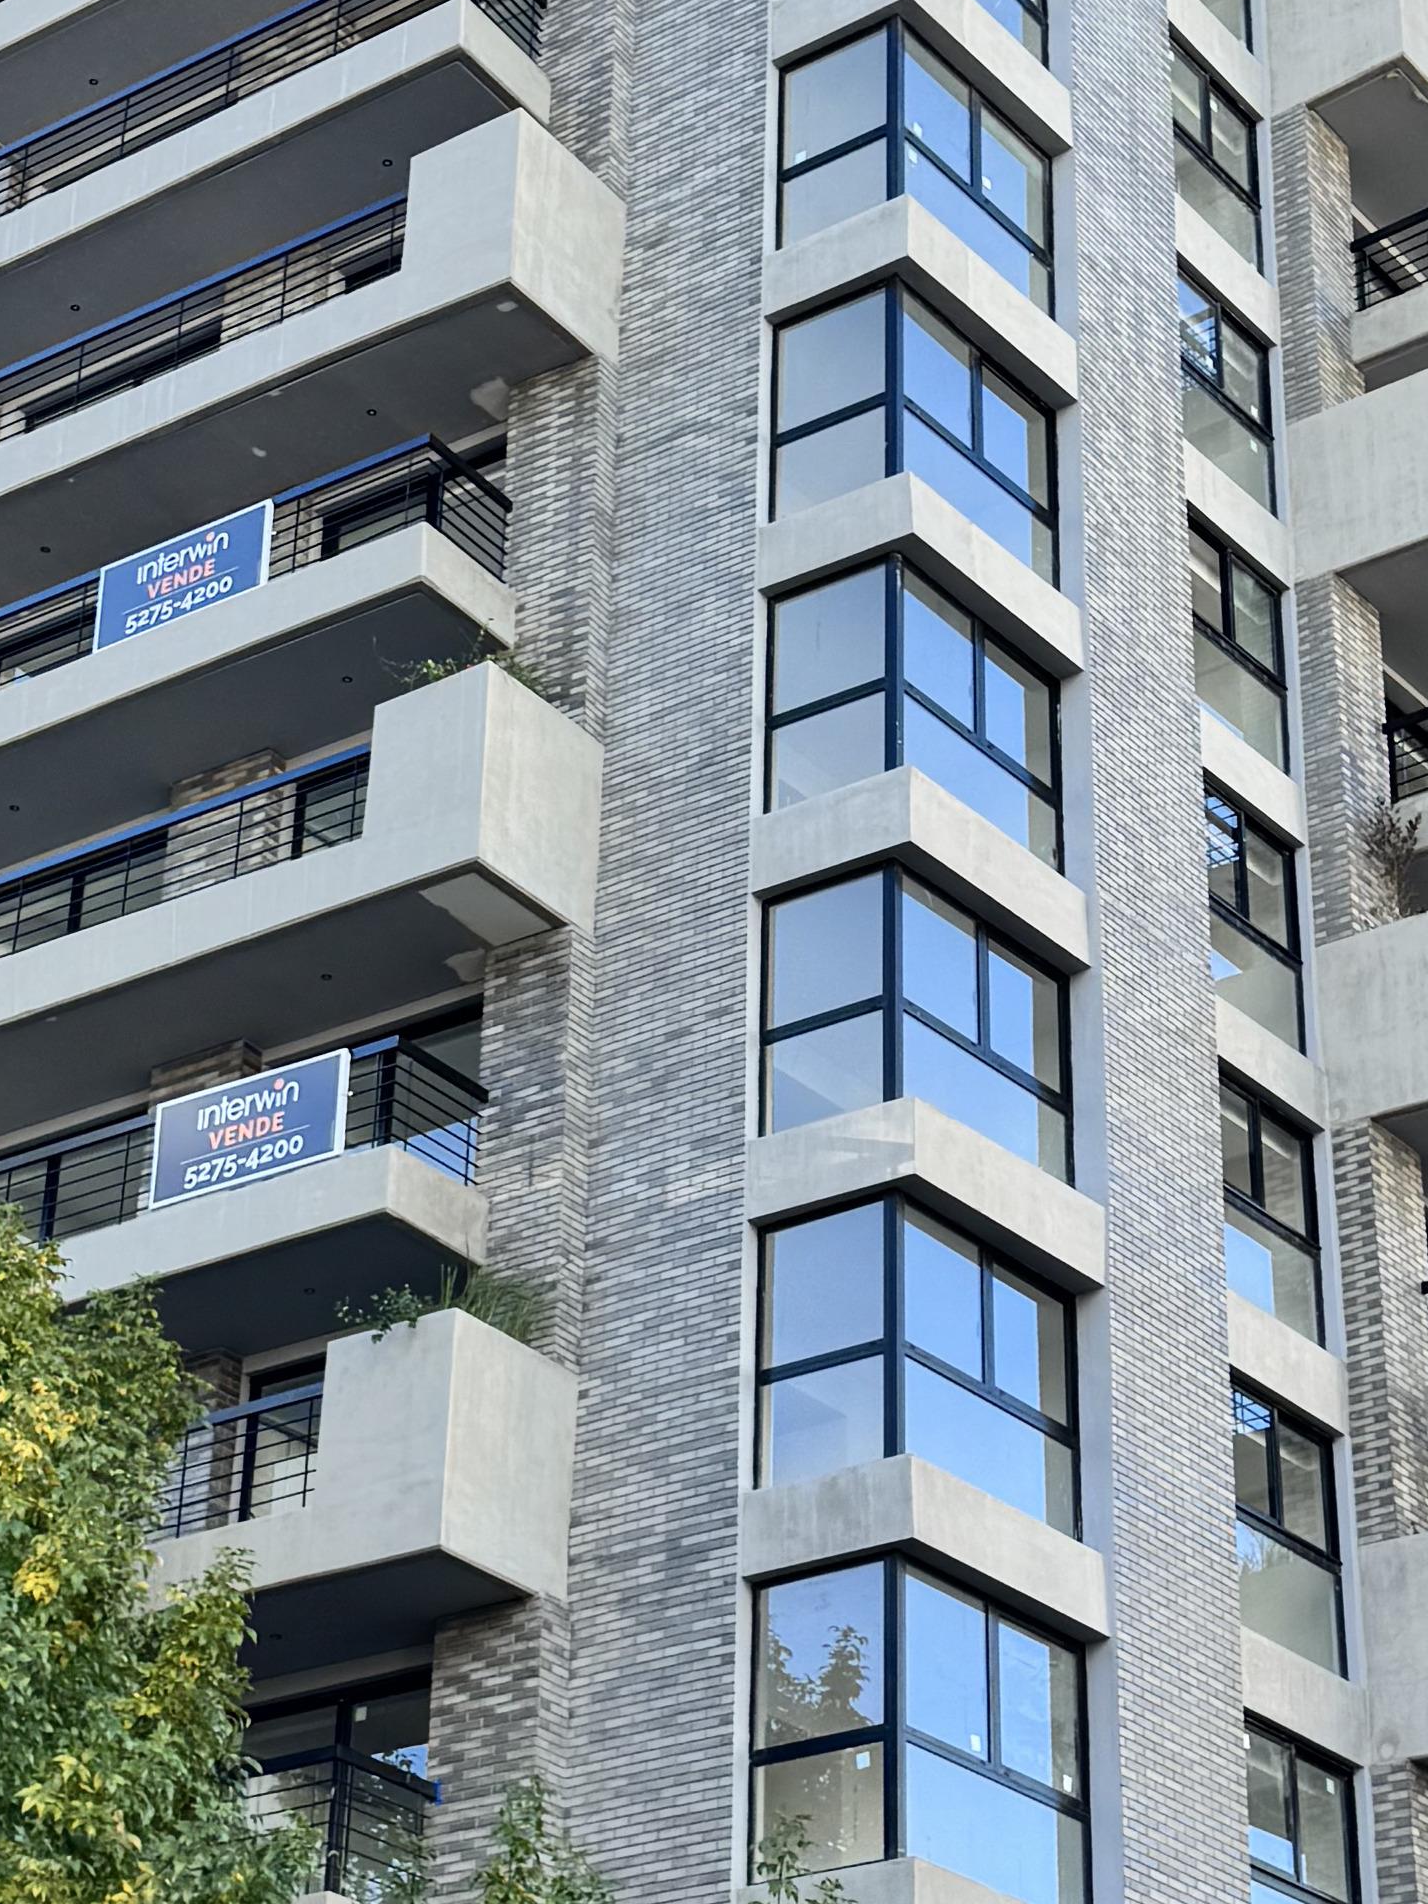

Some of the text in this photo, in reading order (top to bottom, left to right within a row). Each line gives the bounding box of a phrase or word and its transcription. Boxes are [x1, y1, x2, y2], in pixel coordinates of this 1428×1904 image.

[137, 531, 229, 585] interwin
[146, 558, 216, 600] VENDE
[124, 575, 234, 635] 5275-4200
[197, 1078, 300, 1131] interwin
[208, 1111, 285, 1150] VENDE
[184, 1134, 304, 1189] 5275-4200
